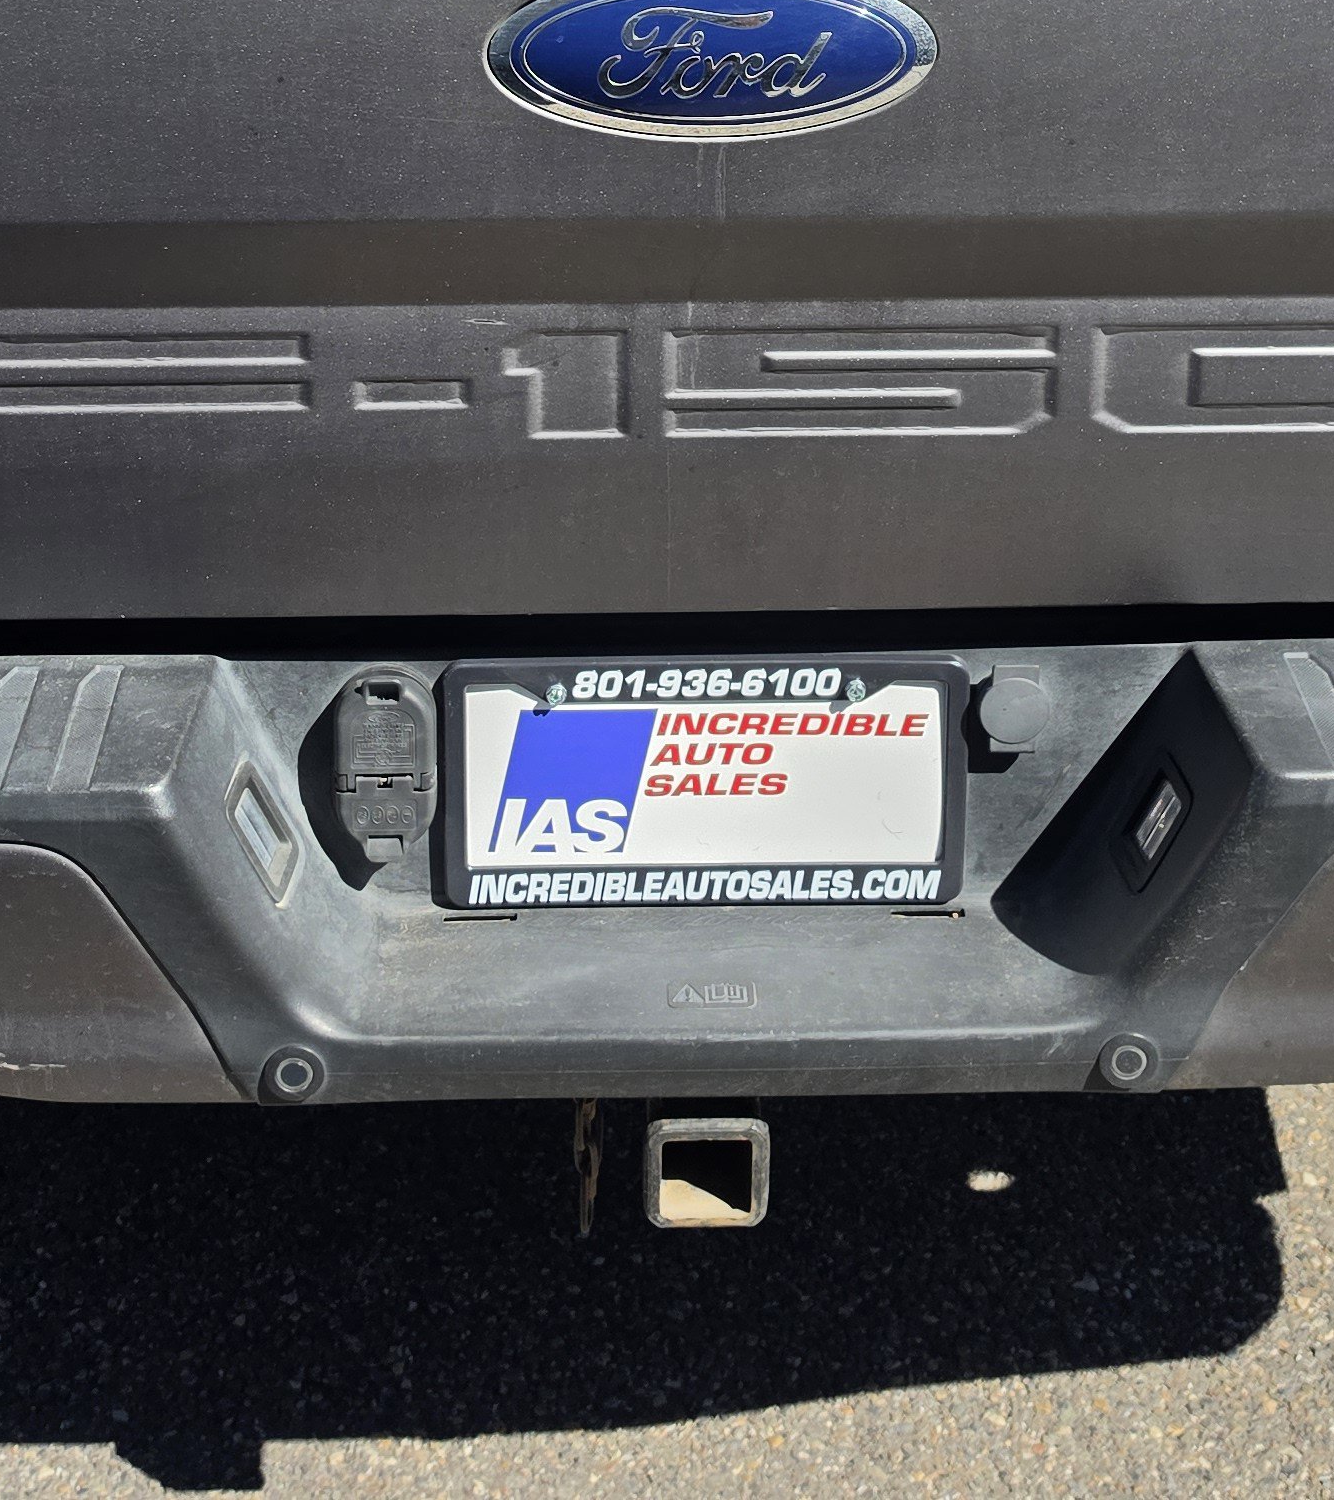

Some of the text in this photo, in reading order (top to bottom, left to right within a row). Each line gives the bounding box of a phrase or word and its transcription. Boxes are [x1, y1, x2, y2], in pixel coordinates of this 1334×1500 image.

[597, 6, 832, 99] Ford
[571, 668, 842, 699] 801-936-6100
[656, 713, 929, 736] INCREDIBLE
[650, 742, 774, 766] AUTO
[644, 773, 788, 796] SALES
[494, 798, 629, 855] IAS
[467, 869, 943, 905] INCREDIBLEAUTOSALES.COM
